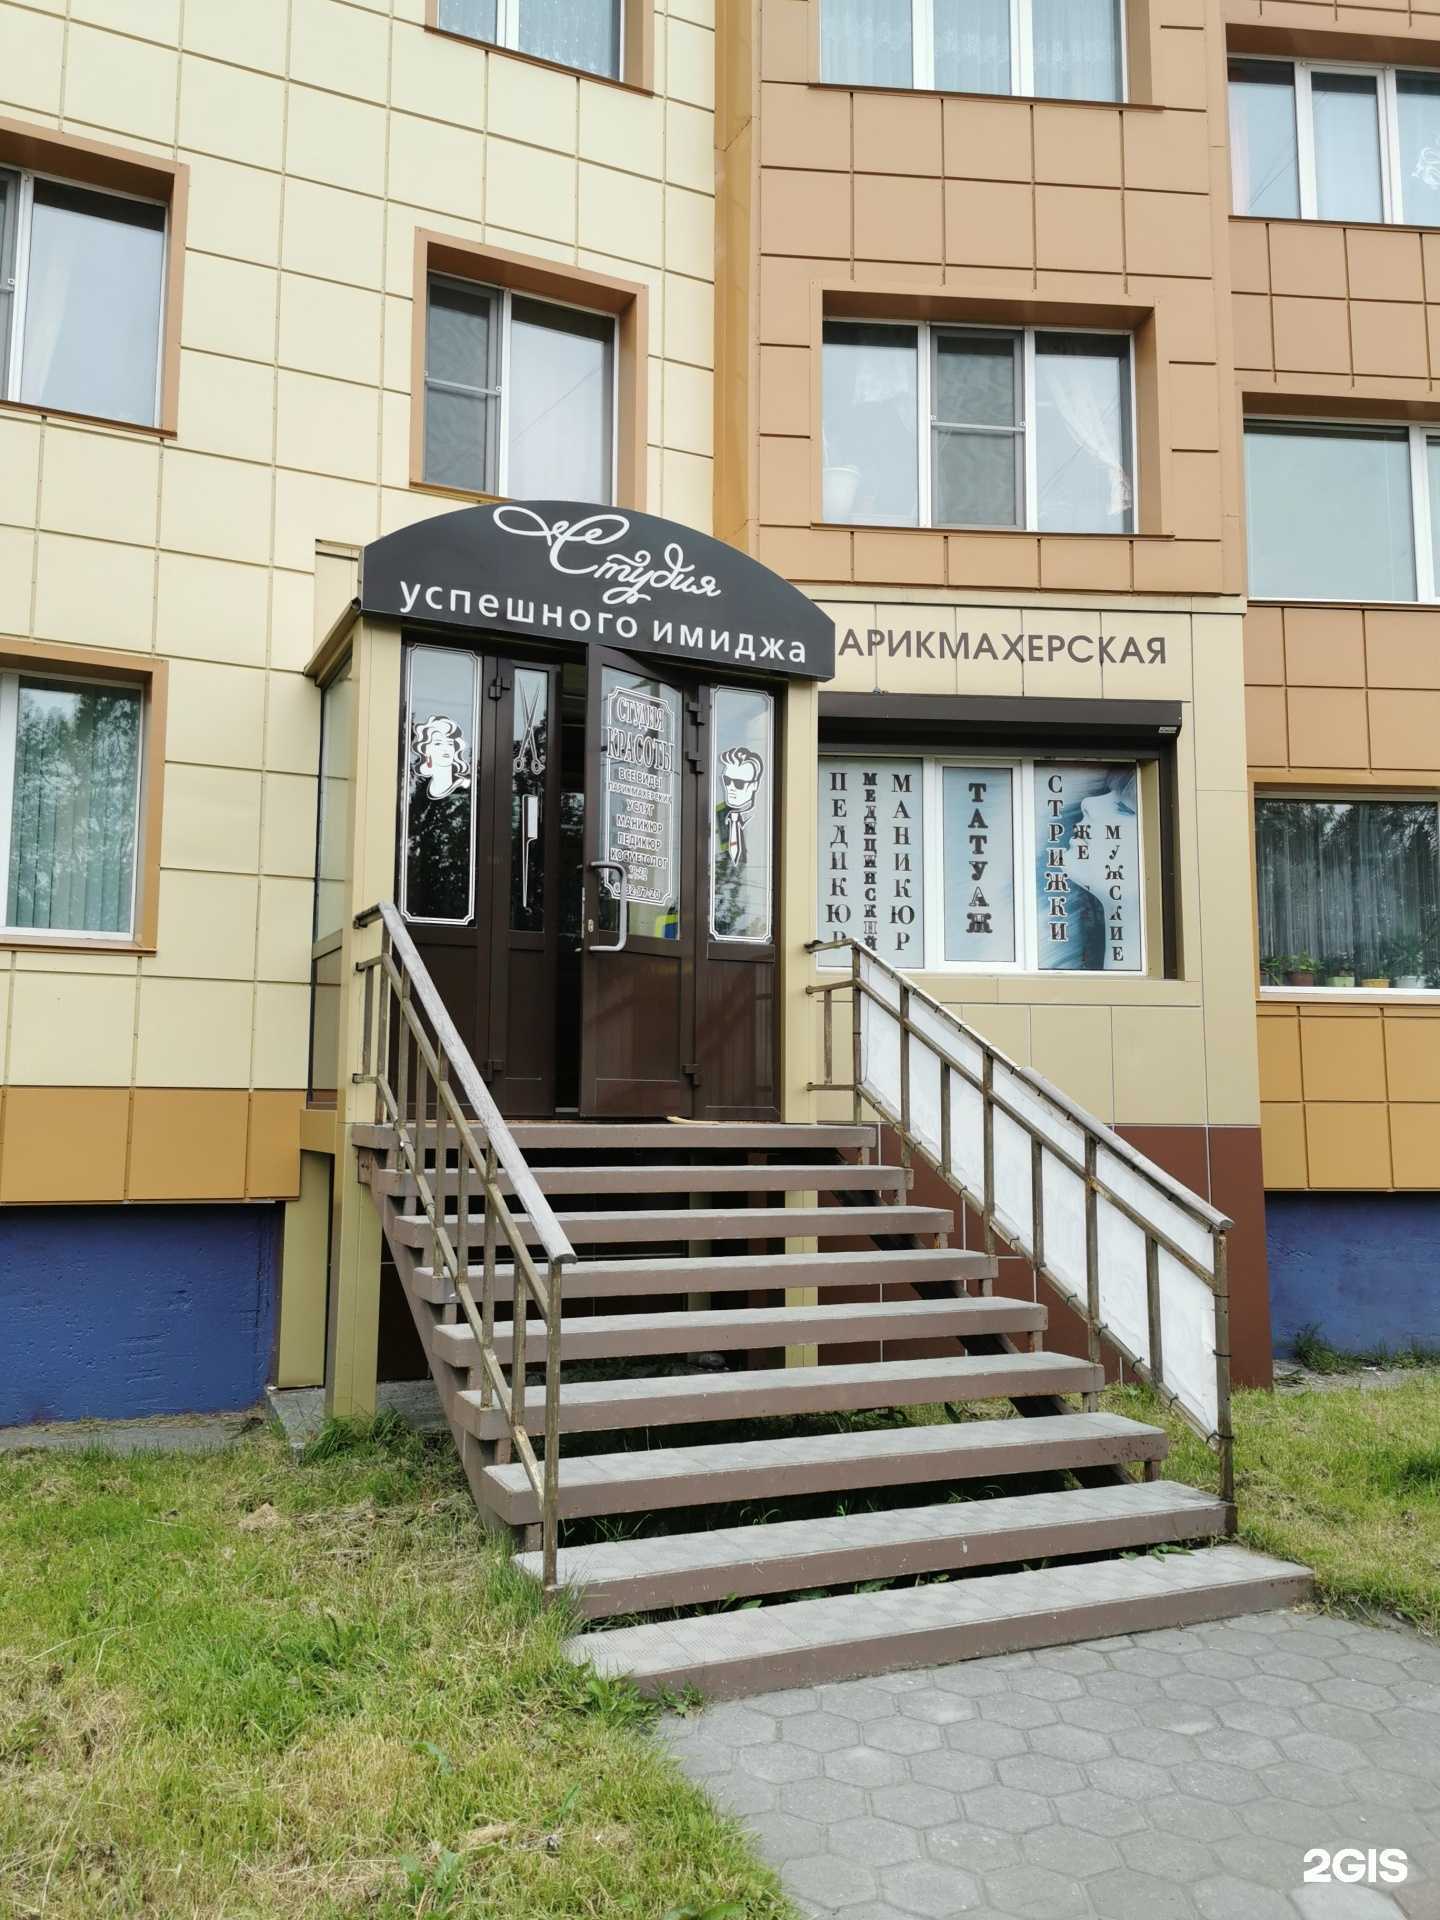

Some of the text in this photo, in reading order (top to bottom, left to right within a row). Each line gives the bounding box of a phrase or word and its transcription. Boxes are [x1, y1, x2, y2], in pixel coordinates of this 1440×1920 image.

[493, 505, 722, 605] Студия
[400, 581, 806, 664] успешного имиджа
[838, 628, 1167, 665] АРИКМАХЕРСКАЯ
[616, 697, 665, 733] СТУДИЯ
[607, 727, 675, 773] КРАСОТЫ
[618, 767, 663, 788] ВСЕ ВИДЫ
[617, 815, 664, 833] МАНИКЮР
[626, 799, 655, 817] УСЛУГ
[610, 848, 669, 870] КОСМЕТОЛОГ
[618, 832, 662, 850] ПЕДИКЮР
[965, 783, 993, 934] ТАТУАЖ
[1044, 775, 1070, 943] СТРИЖКИ
[890, 774, 916, 951] МАНИКЮР
